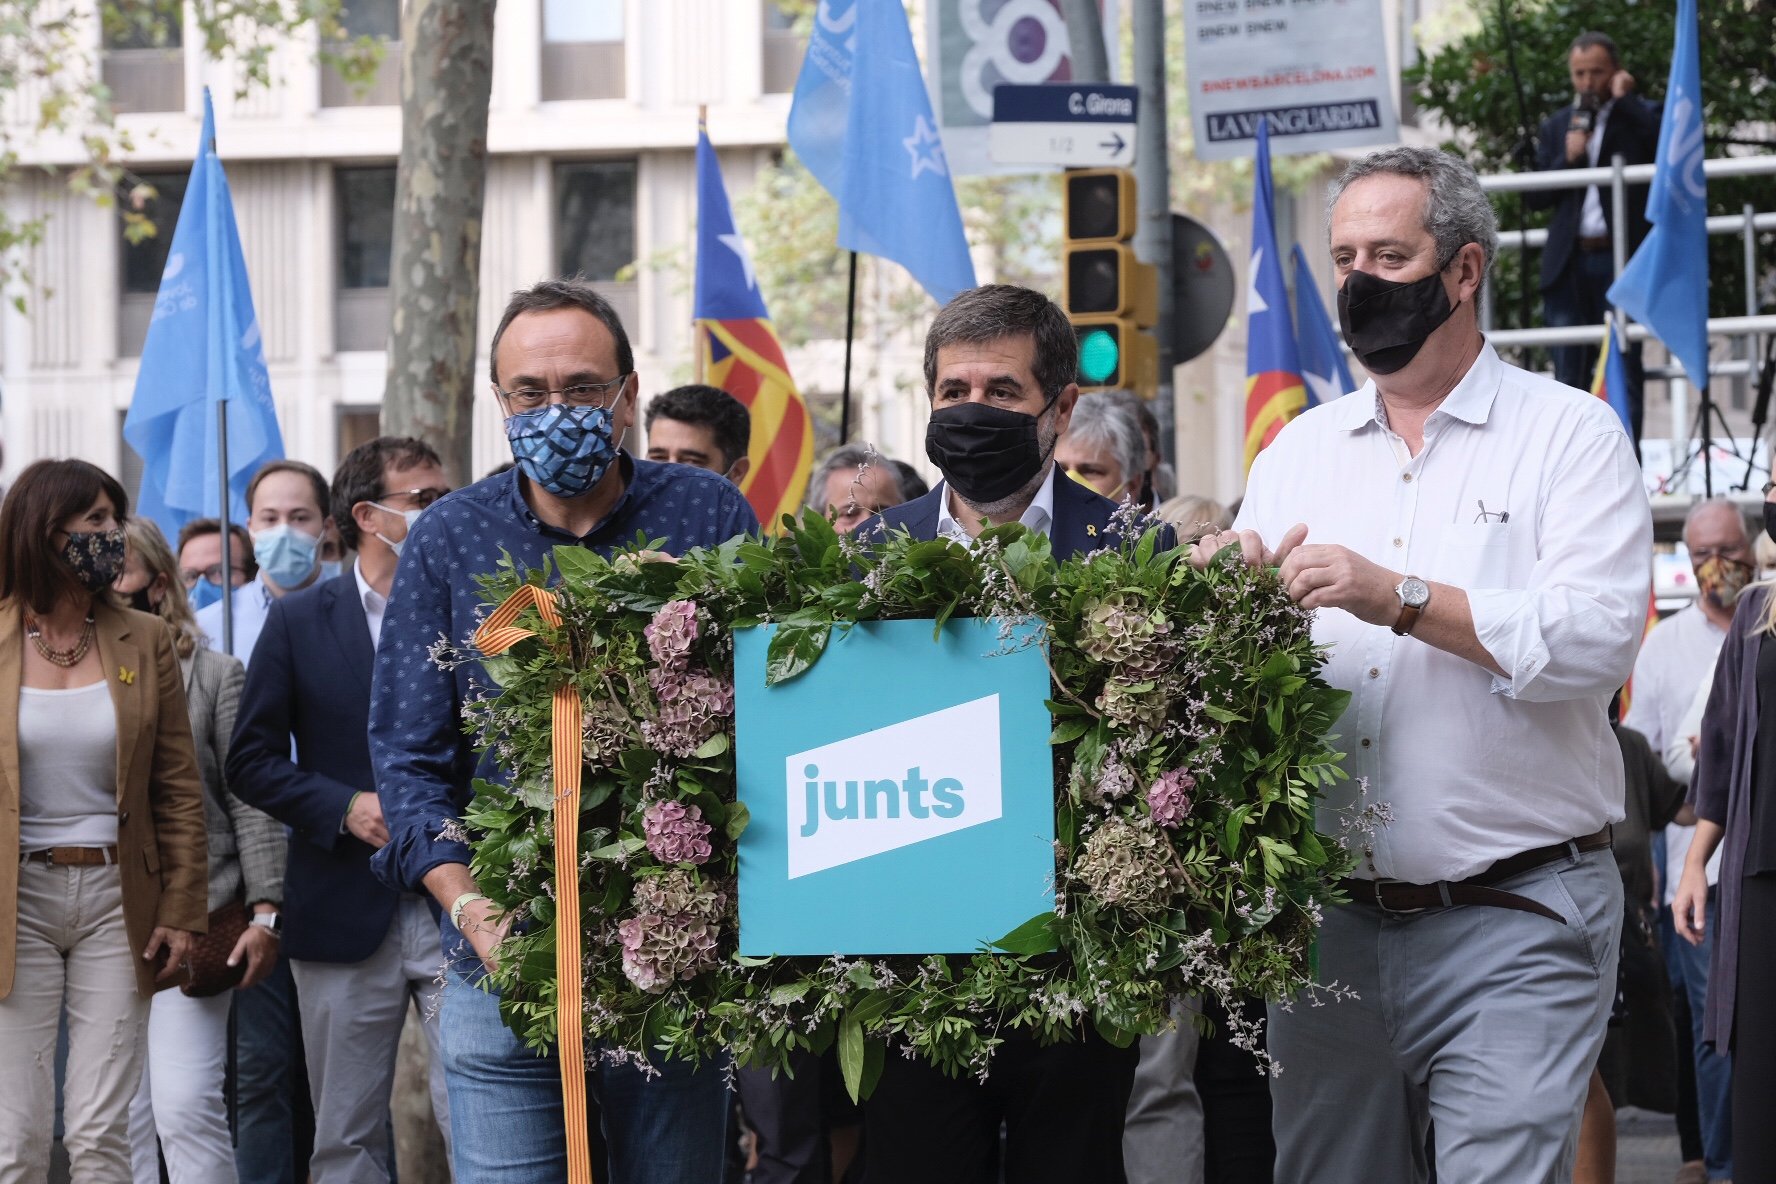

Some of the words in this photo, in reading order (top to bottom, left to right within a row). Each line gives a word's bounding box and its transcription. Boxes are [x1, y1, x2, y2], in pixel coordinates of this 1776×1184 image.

[1068, 92, 1086, 115] C.
[1086, 93, 1133, 116] Girona
[1209, 115, 1240, 140] LA
[800, 764, 964, 837] junts
